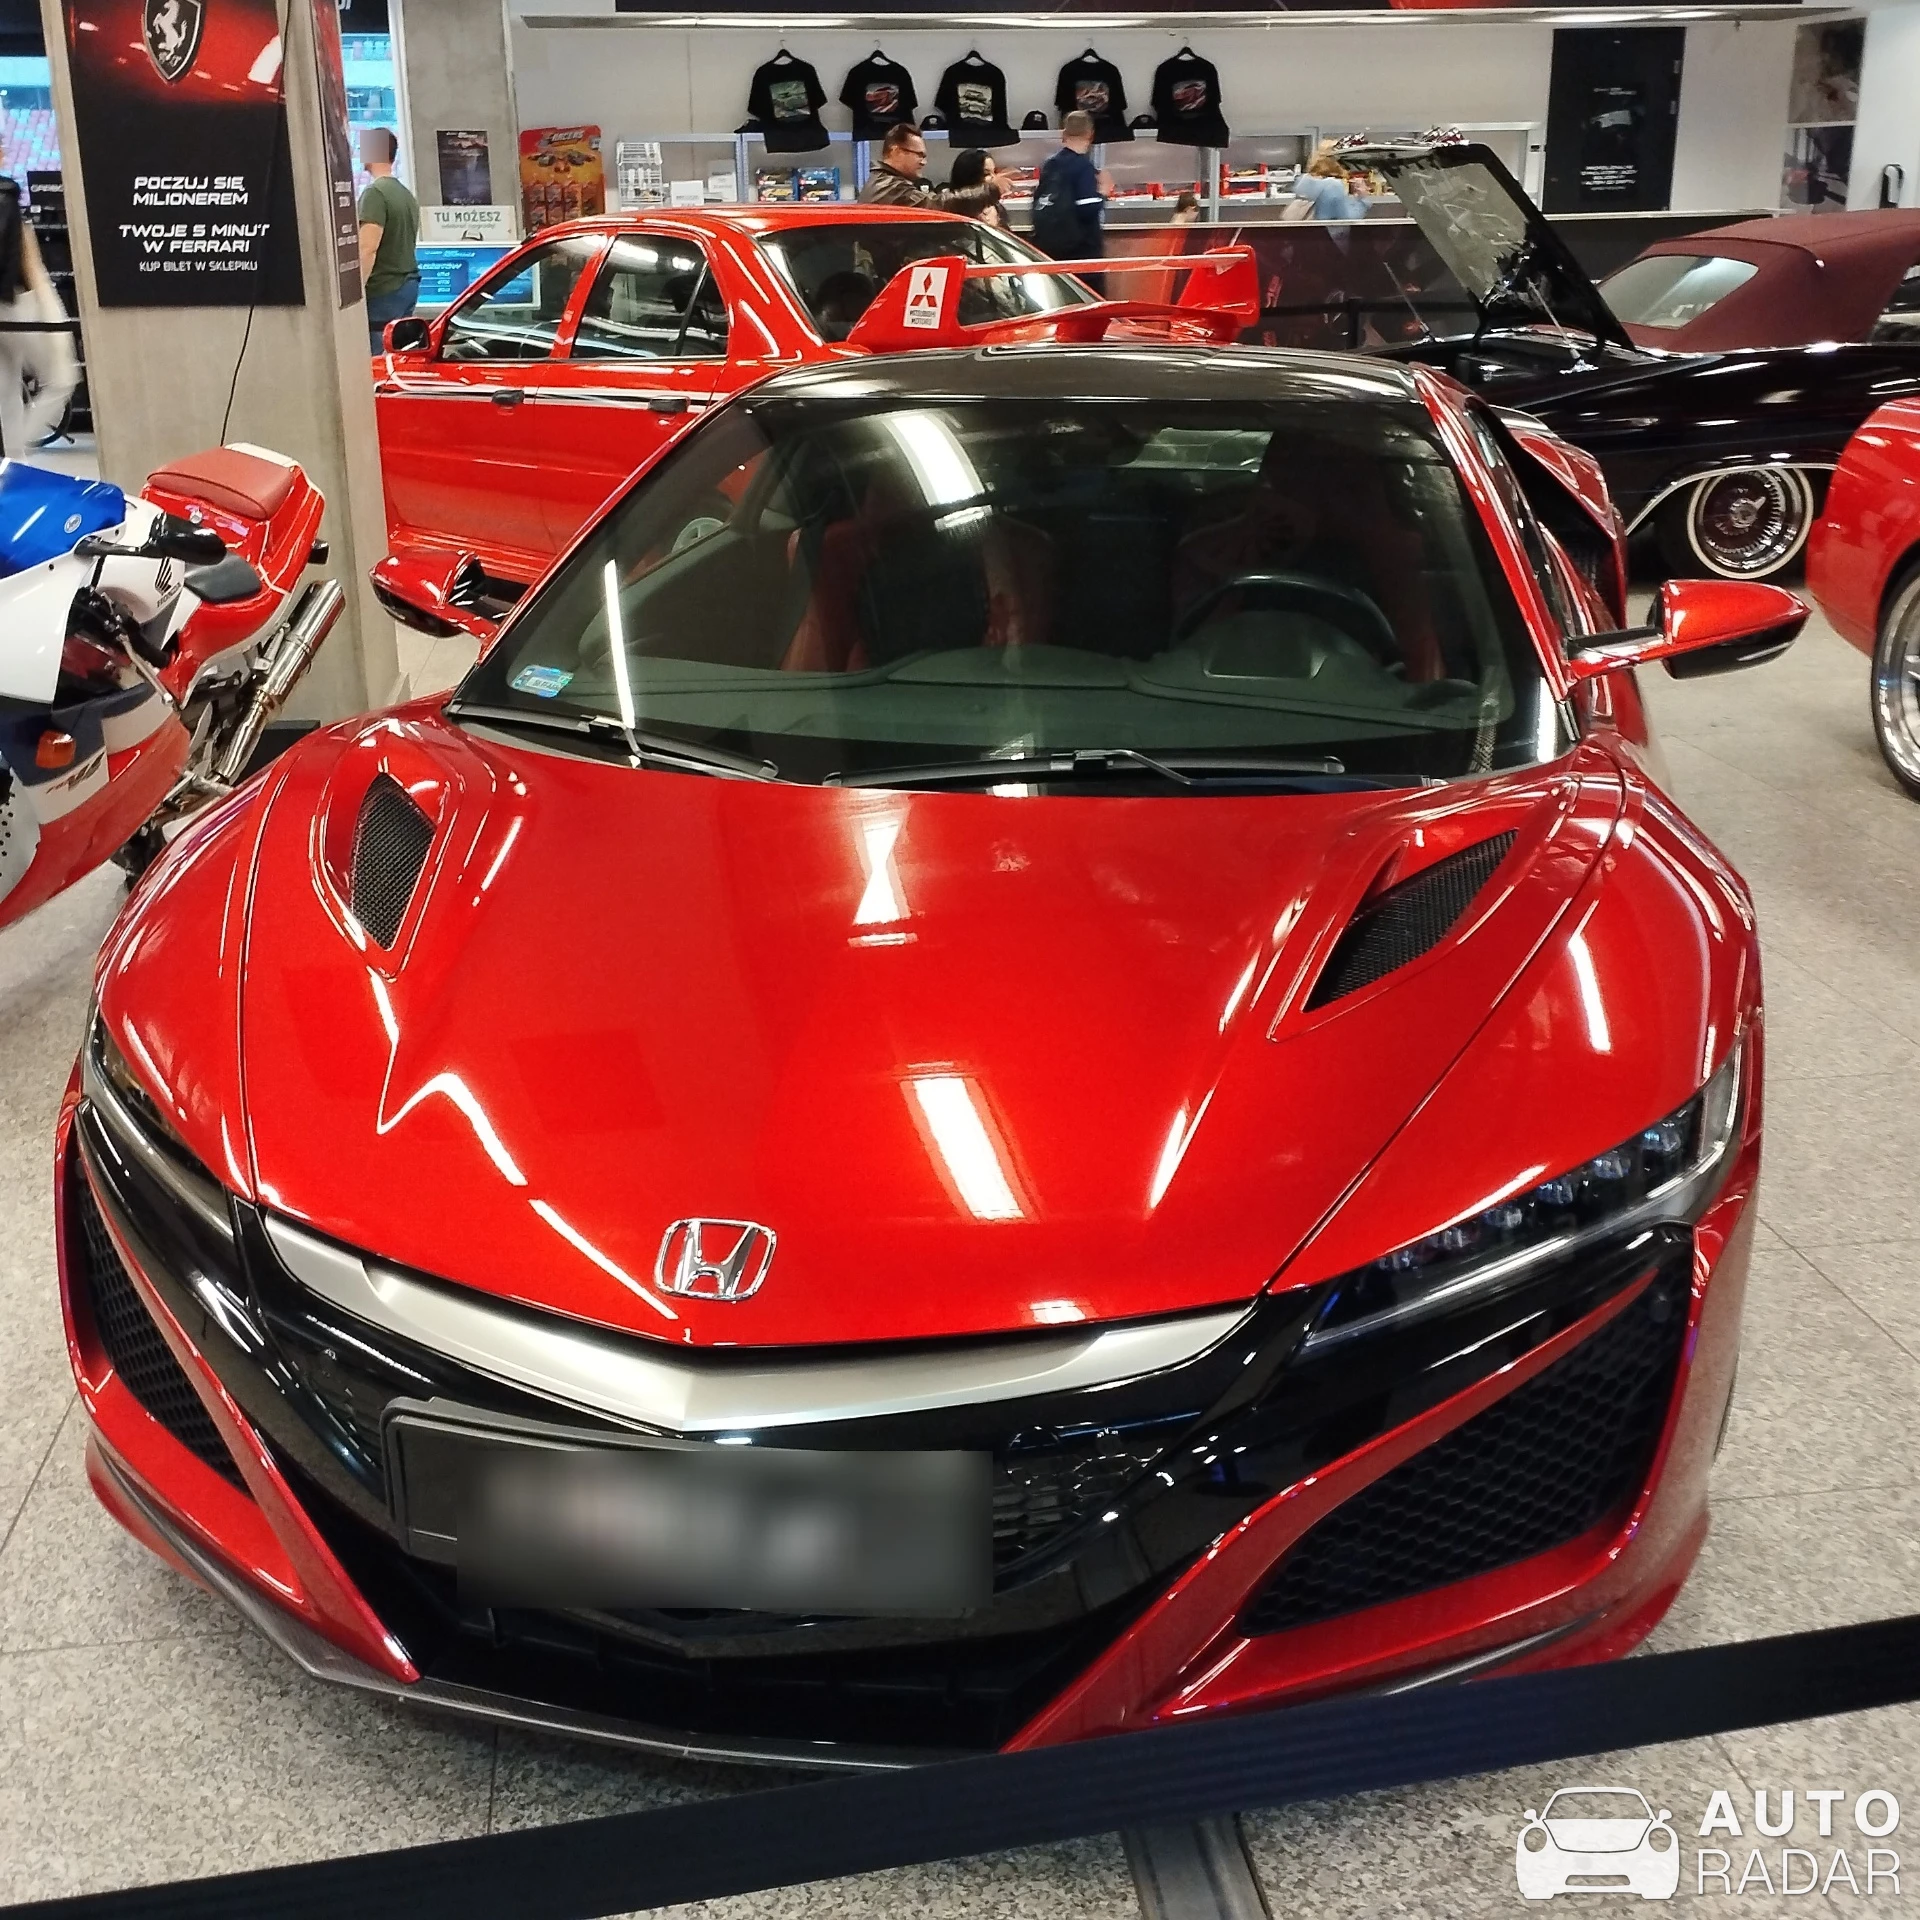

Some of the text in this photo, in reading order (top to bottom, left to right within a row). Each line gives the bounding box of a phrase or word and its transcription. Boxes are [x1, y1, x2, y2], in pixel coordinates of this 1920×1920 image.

[134, 176, 246, 191] POCZUJ SIĘ
[132, 192, 249, 206] MILIONEREM
[434, 211, 450, 223] TU
[118, 224, 270, 238] TWOJE 5 MINUT
[143, 240, 250, 253] W FERRARI
[139, 260, 258, 272] KUP BILET W SKLEPIKU
